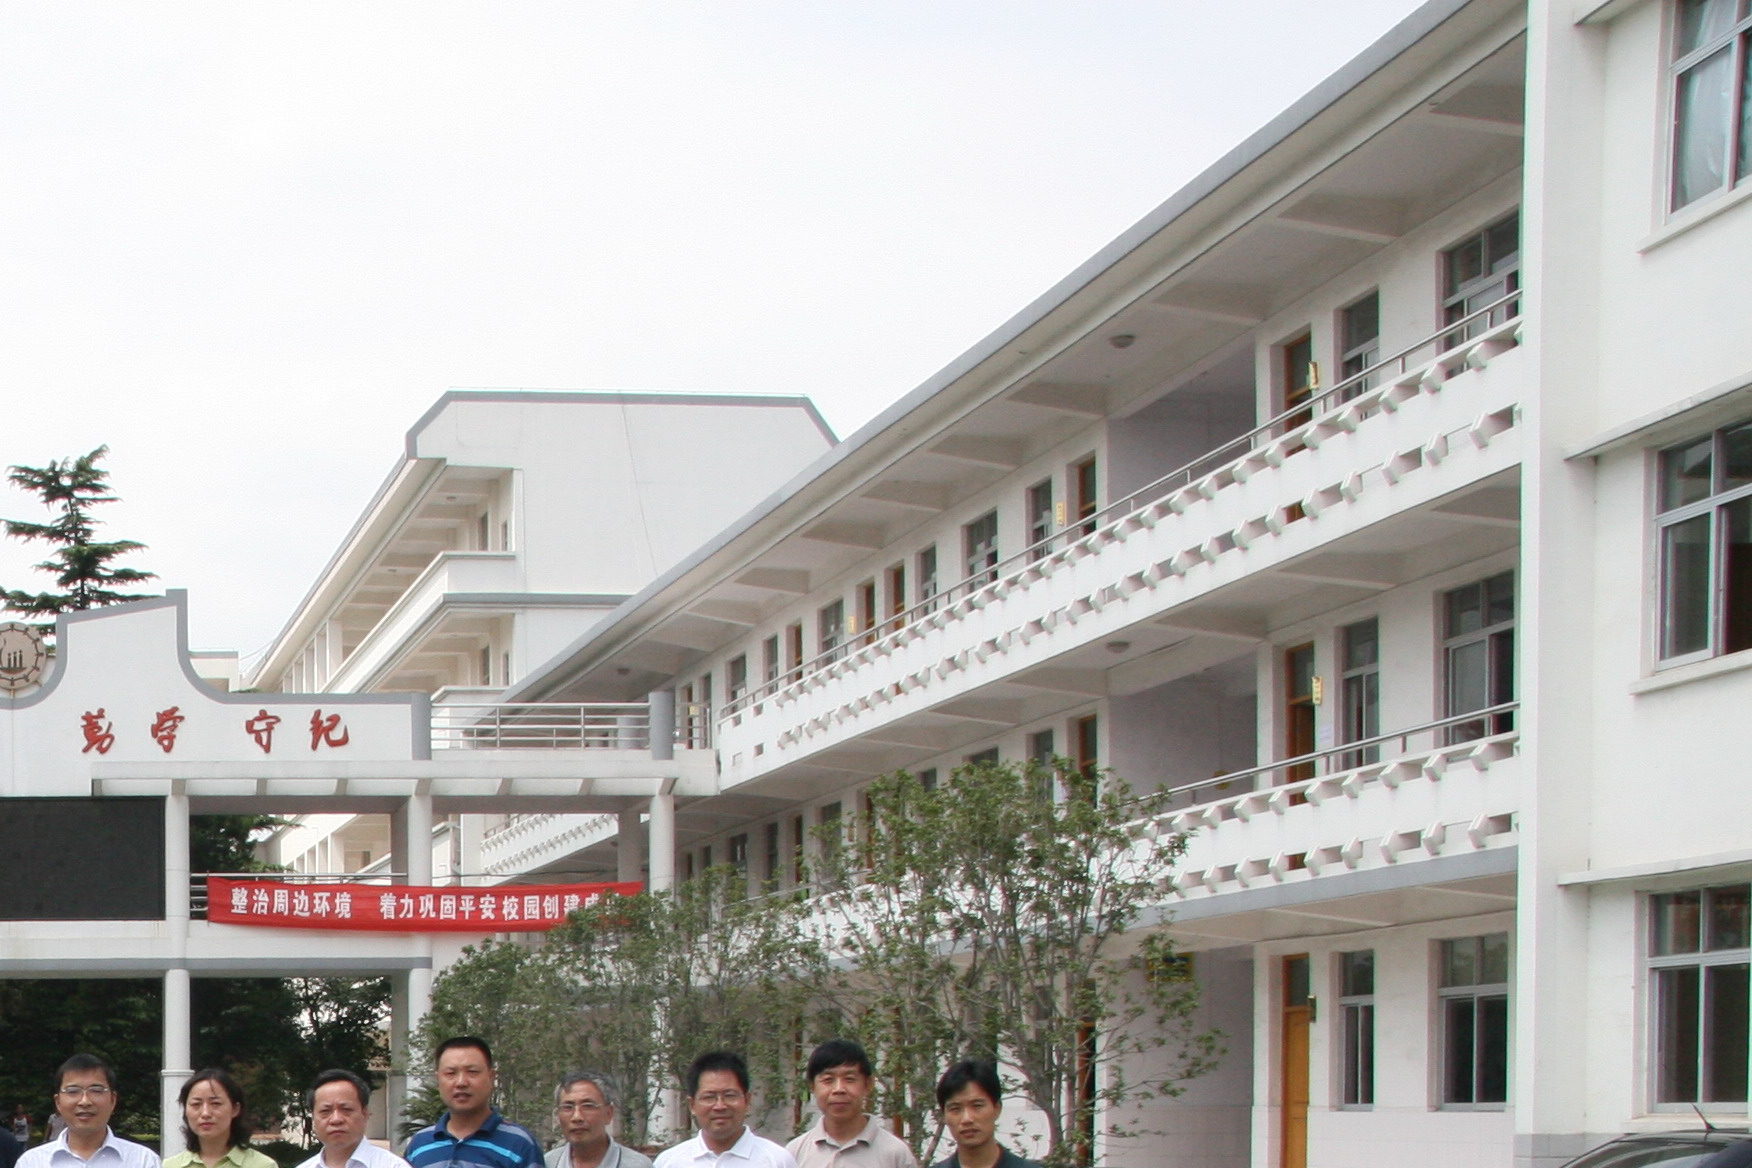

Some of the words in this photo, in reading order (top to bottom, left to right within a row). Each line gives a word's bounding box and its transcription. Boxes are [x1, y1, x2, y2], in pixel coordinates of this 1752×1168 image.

[246, 709, 350, 753] 守纪
[231, 887, 352, 919] 整治周边环境
